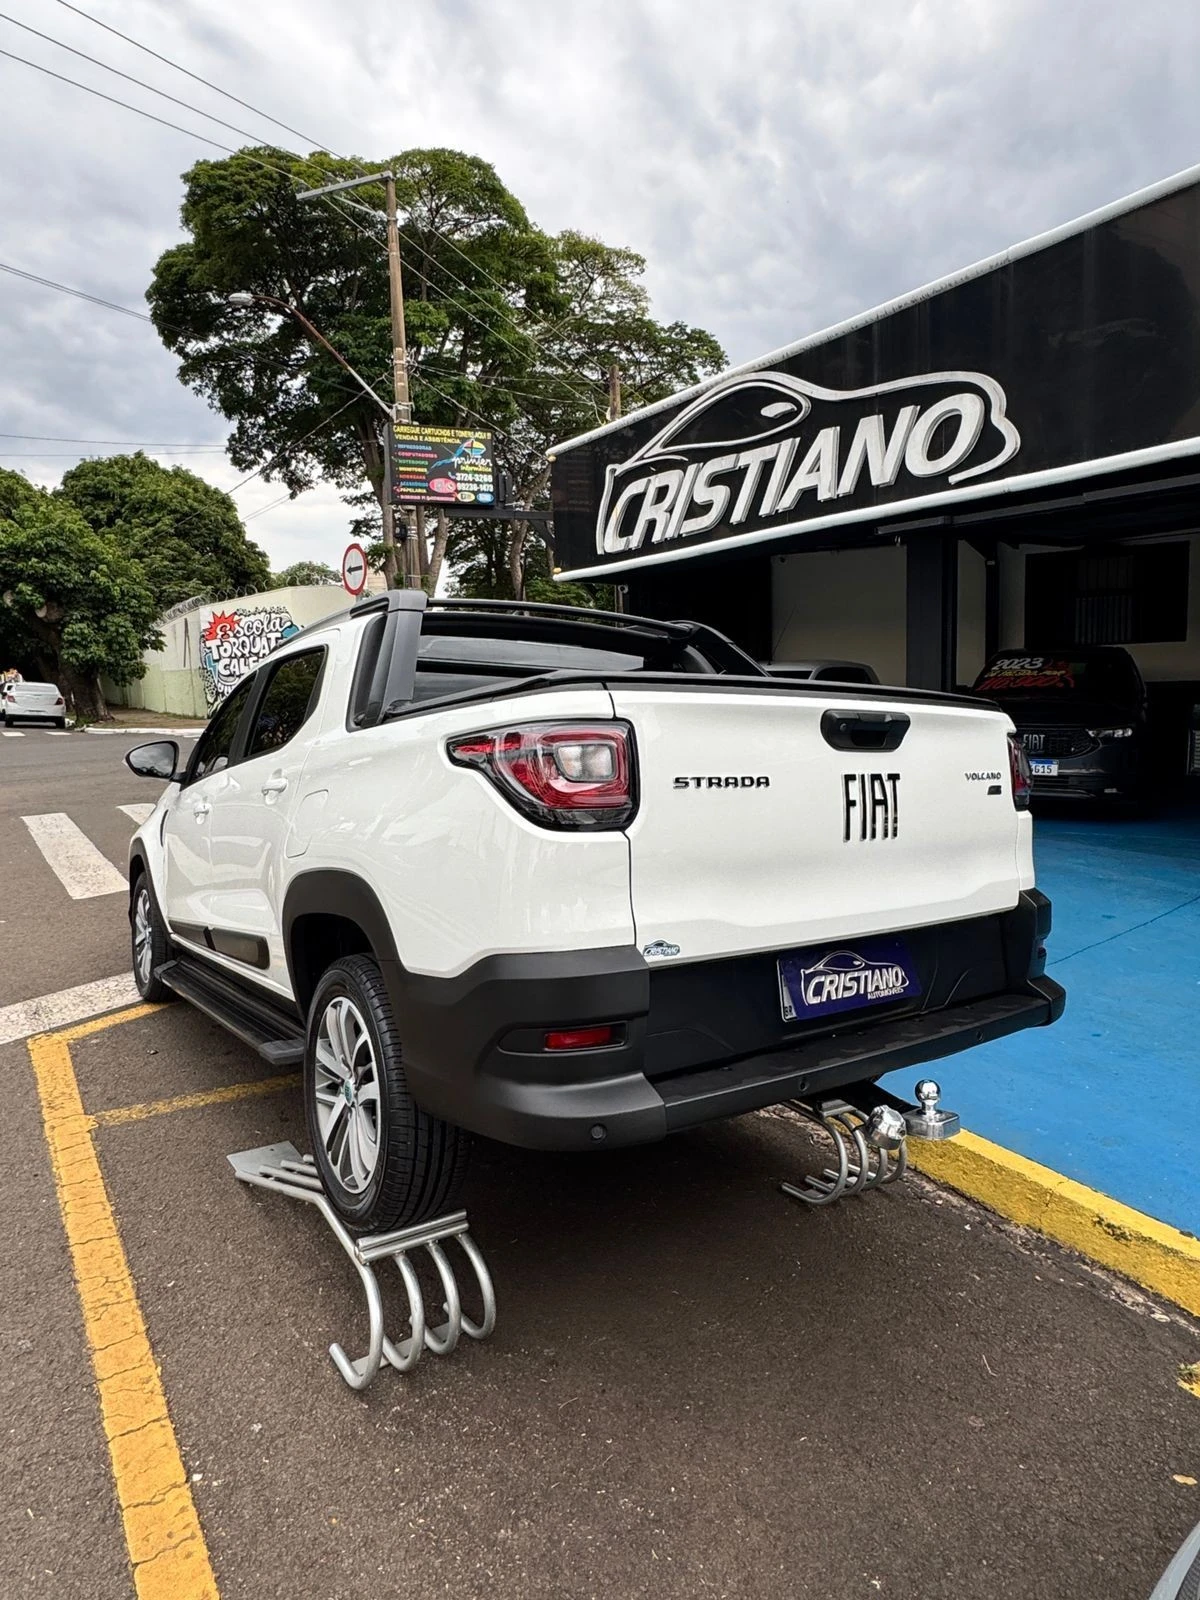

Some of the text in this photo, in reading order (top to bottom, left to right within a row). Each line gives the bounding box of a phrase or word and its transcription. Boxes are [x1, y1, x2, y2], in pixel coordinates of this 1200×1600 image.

[421, 427, 450, 436] CARTUCHOS
[605, 393, 985, 553] CRISTIANO
[216, 613, 283, 638] Escola
[205, 633, 282, 660] TORQUAT
[991, 658, 1044, 671] 2023
[1023, 734, 1046, 750] FIAT
[673, 776, 771, 789] STRADA
[964, 772, 1002, 781] VOLCANO
[842, 773, 900, 842] FIAT
[806, 966, 902, 1005] CRISTIANO
